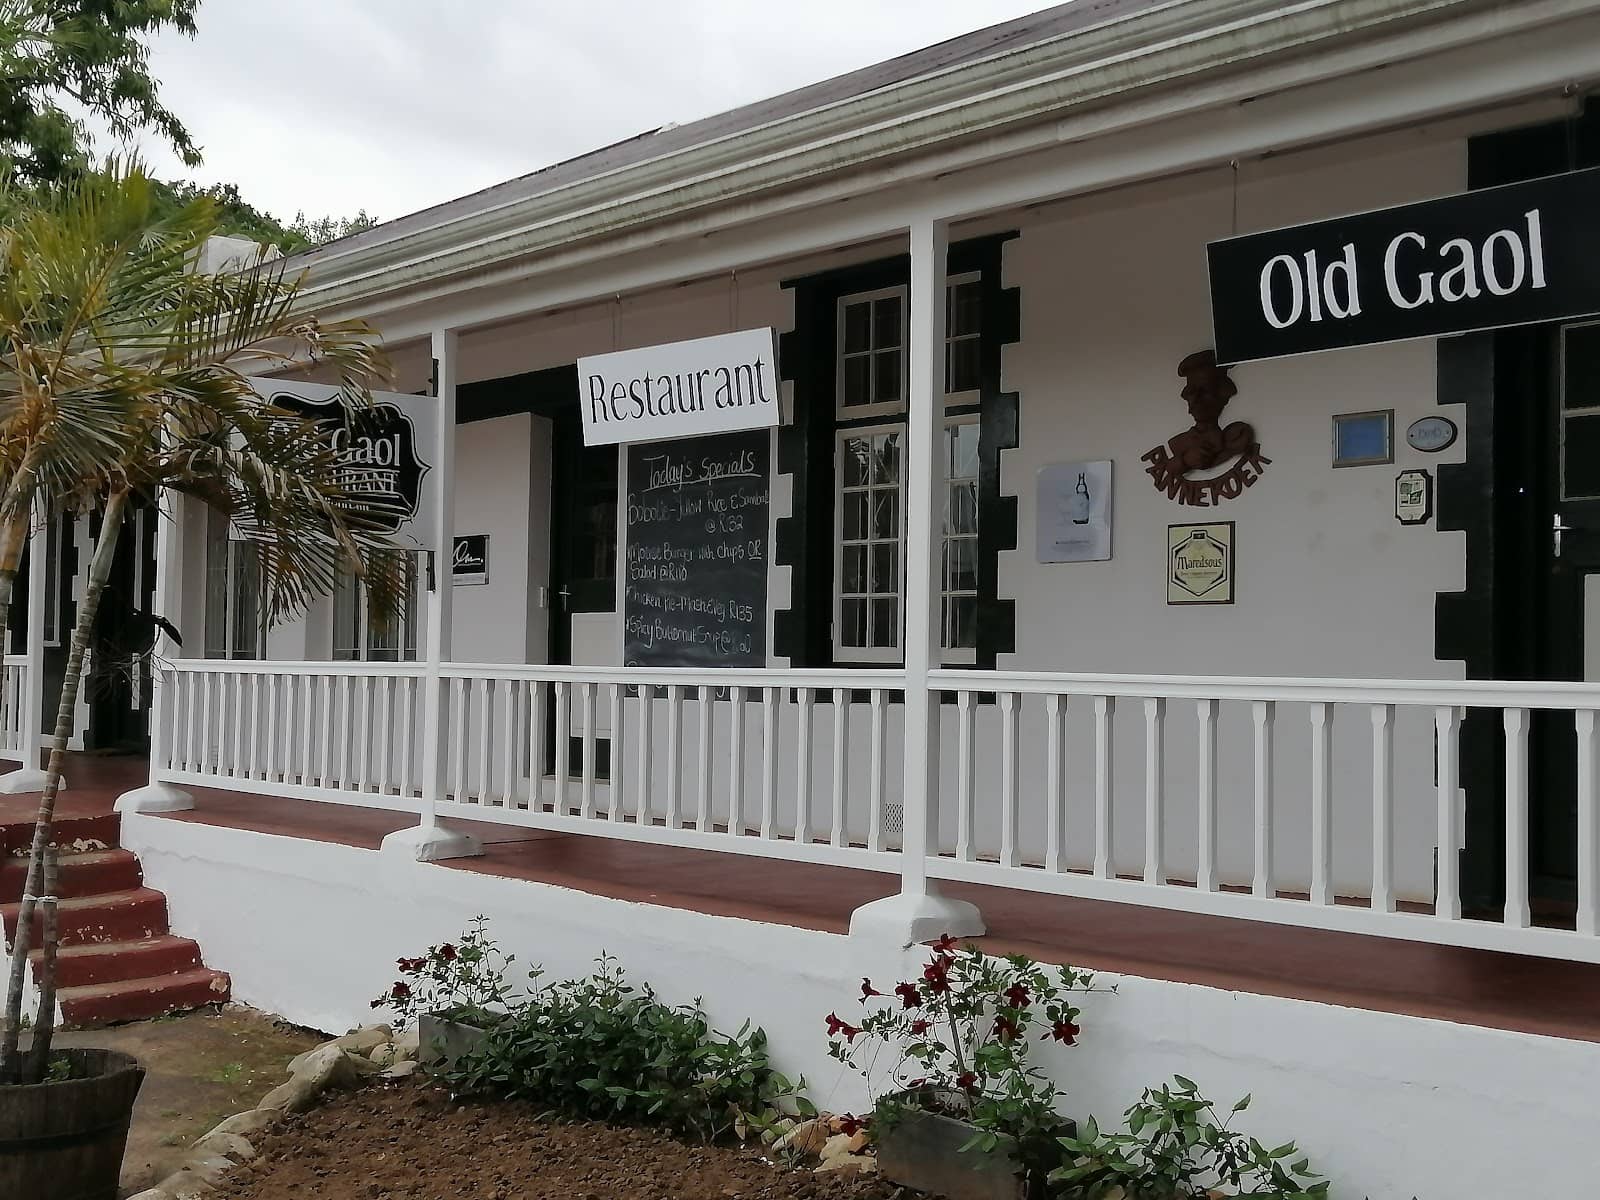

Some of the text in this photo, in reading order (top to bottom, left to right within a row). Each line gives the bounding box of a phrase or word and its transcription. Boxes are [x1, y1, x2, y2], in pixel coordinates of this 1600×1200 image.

[1259, 208, 1547, 328] Old Gaol
[588, 352, 771, 424] Restaurant
[331, 427, 400, 467] Gaol
[643, 449, 755, 493] Today's Specials
[1141, 443, 1272, 507] PANNEKOEK
